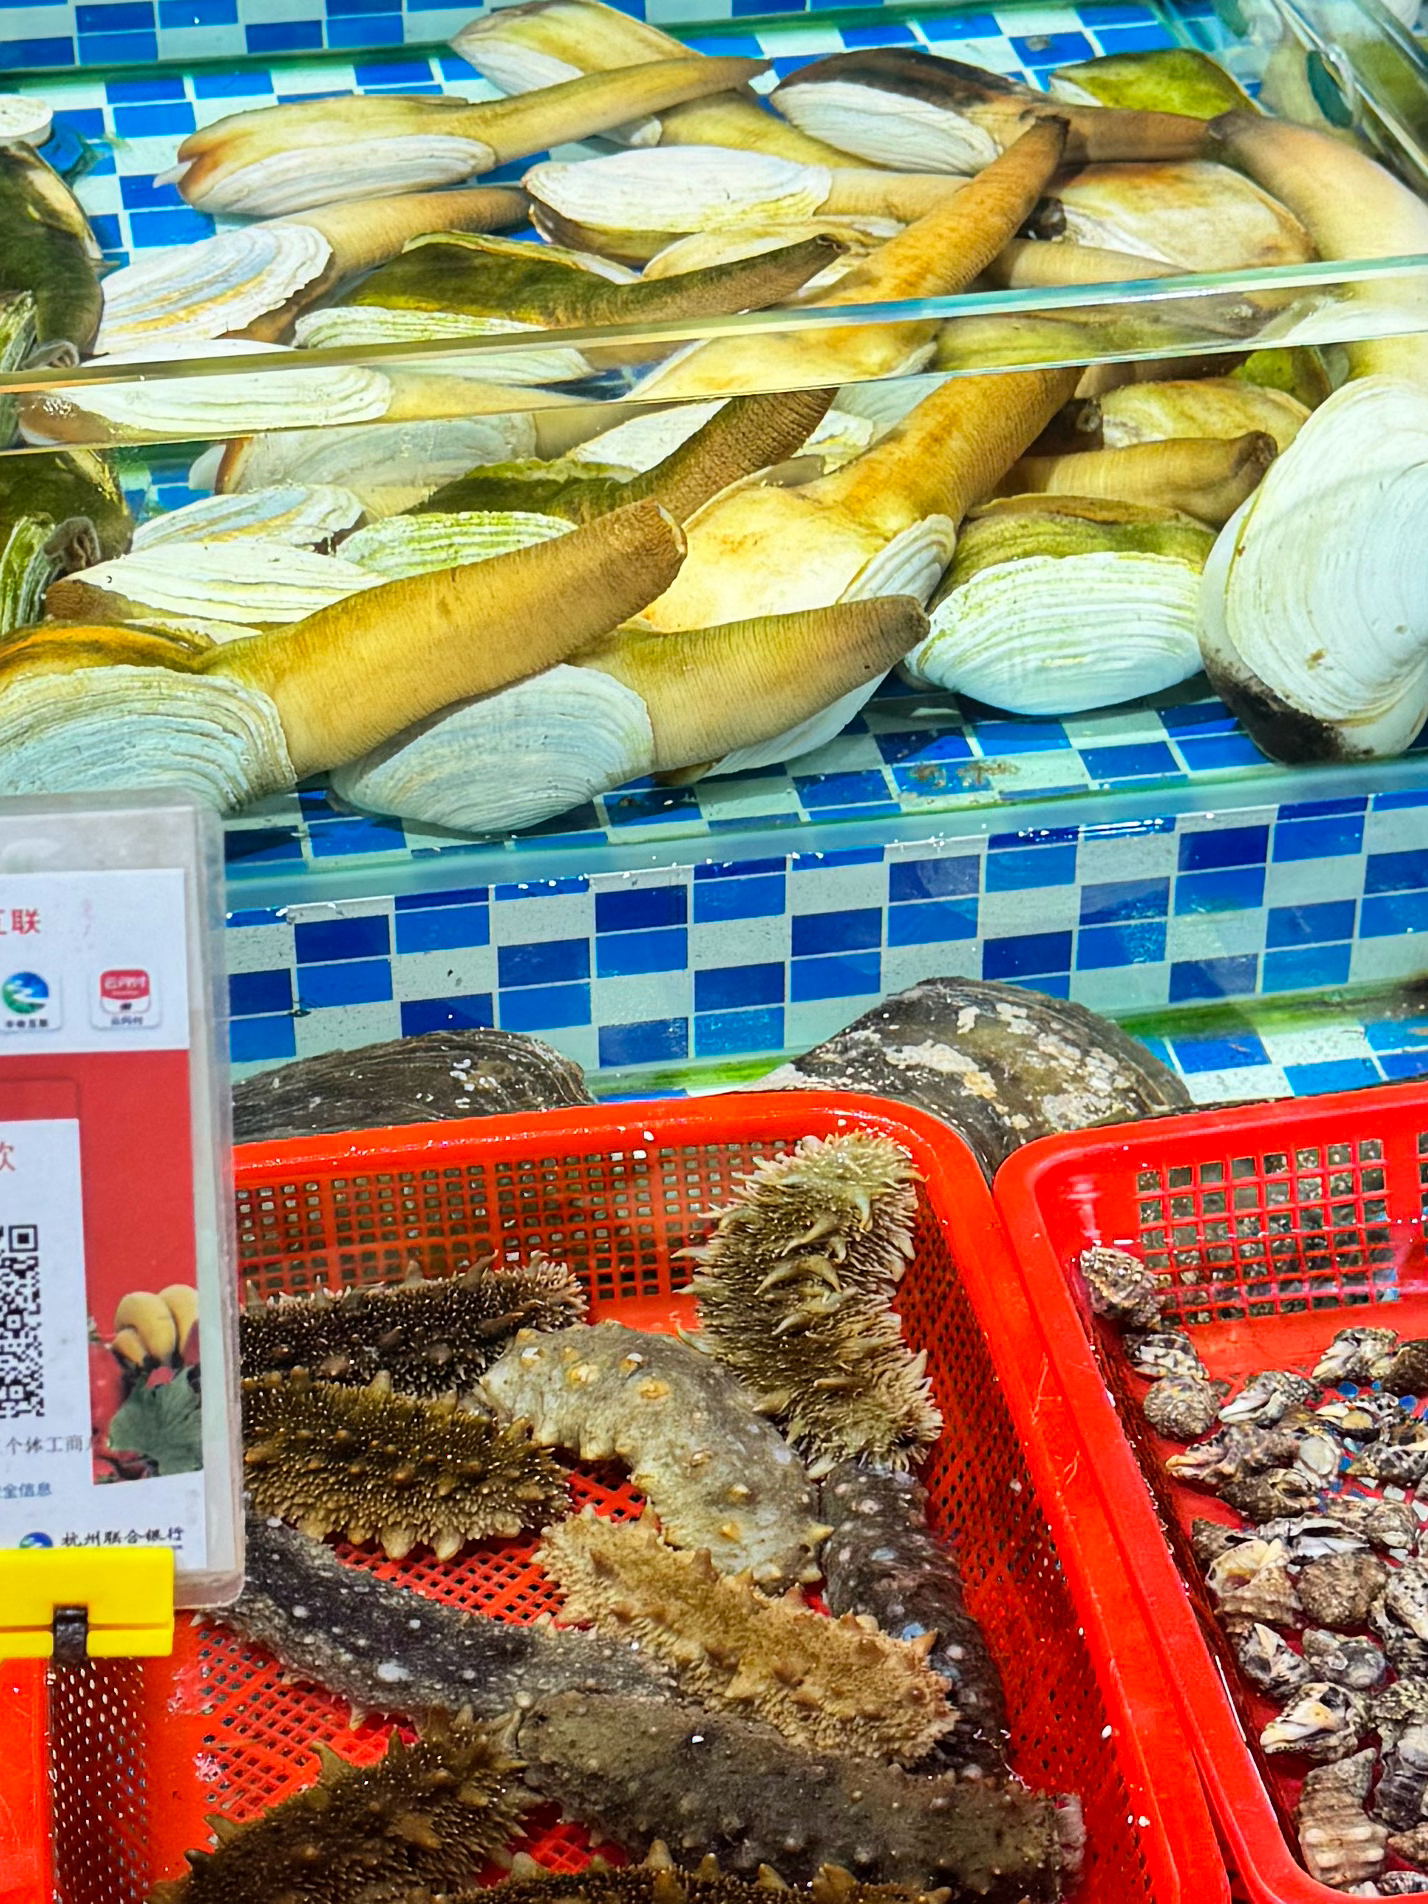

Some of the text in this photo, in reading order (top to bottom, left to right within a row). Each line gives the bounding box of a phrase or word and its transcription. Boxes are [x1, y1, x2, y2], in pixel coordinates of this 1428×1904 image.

[61, 1526, 184, 1547] 杭州联合银行
